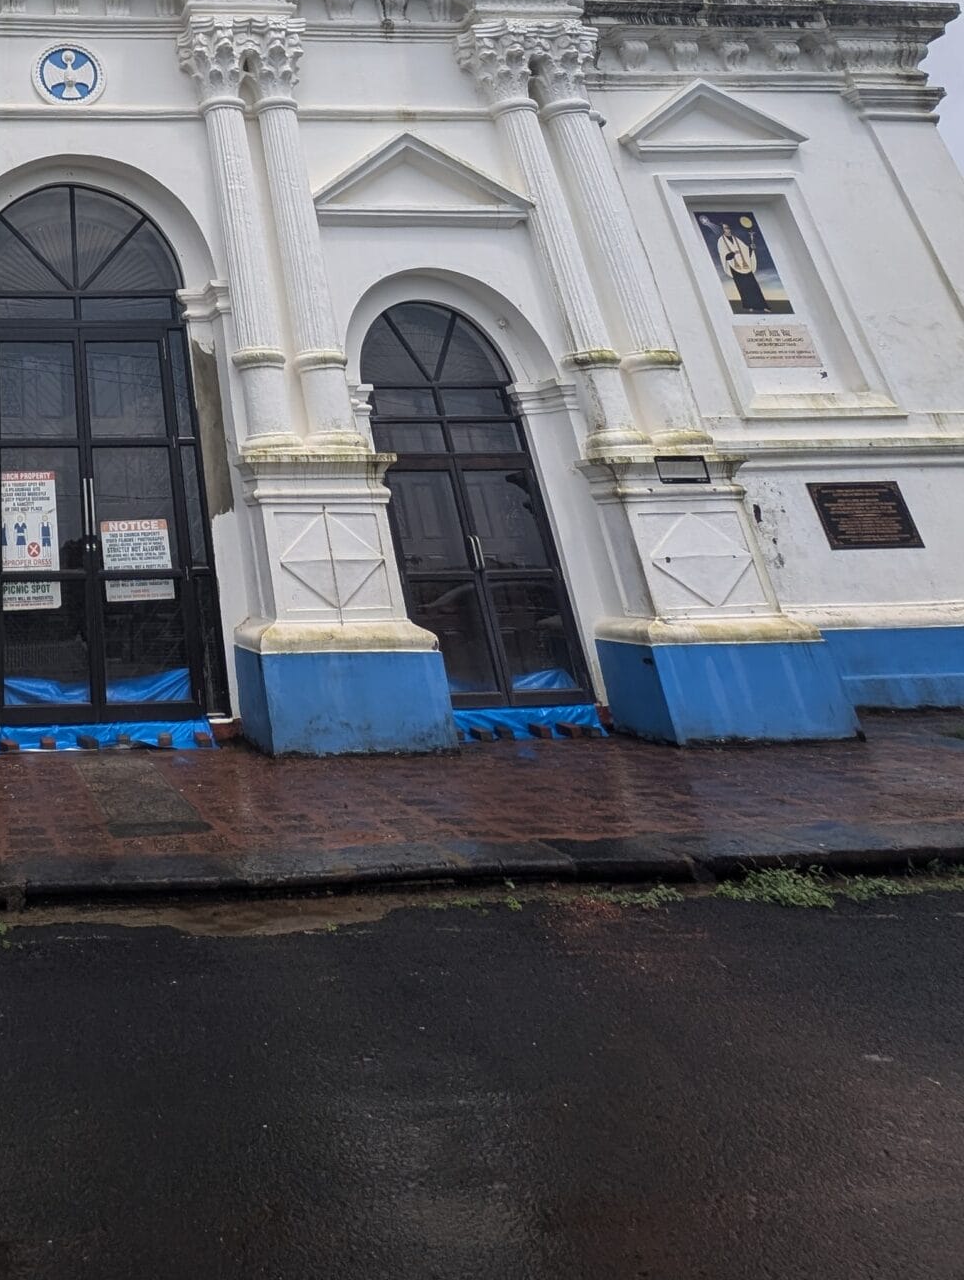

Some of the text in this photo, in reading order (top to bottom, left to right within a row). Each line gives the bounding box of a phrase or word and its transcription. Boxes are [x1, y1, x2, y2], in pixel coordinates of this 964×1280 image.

[20, 472, 50, 480] PROPERTY
[109, 521, 158, 531] NOTICE
[3, 584, 50, 595] PICNIC SPOT
